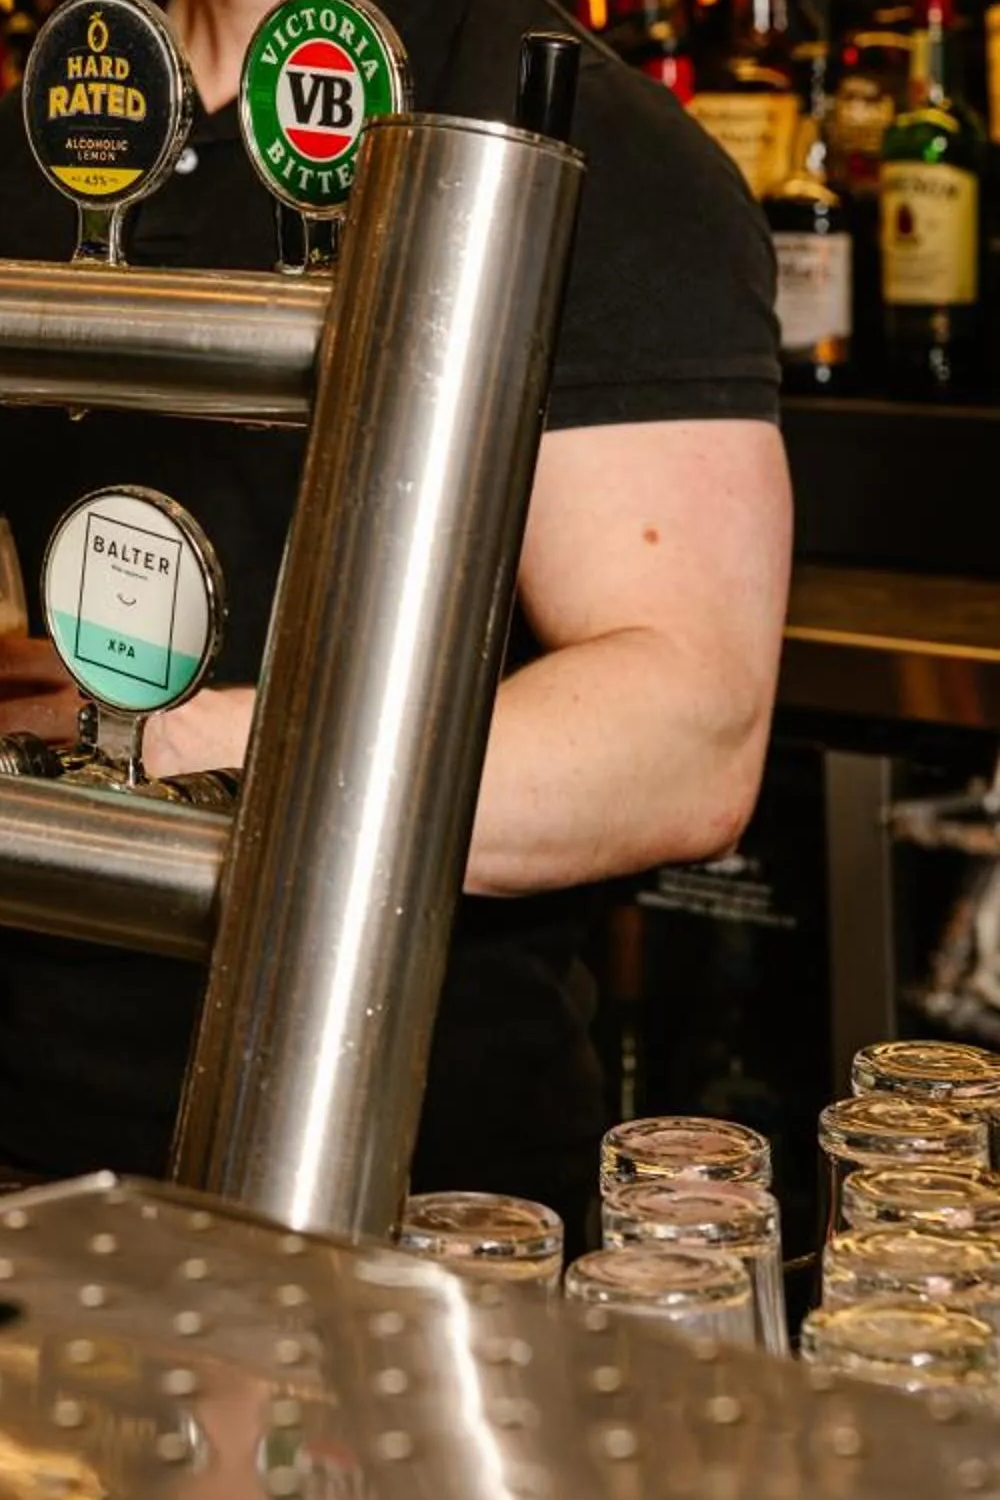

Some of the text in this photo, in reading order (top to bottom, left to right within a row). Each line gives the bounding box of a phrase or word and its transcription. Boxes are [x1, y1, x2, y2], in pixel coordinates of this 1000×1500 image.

[261, 7, 379, 83] VICTORIA
[68, 55, 129, 80] HARD
[49, 82, 147, 121] RATED
[286, 71, 354, 128] VB
[65, 137, 129, 151] ALCOHOLIC
[77, 150, 116, 161] LEMON
[266, 138, 358, 194] BITTE
[93, 534, 170, 576] BALTER
[107, 638, 136, 659] XPA
